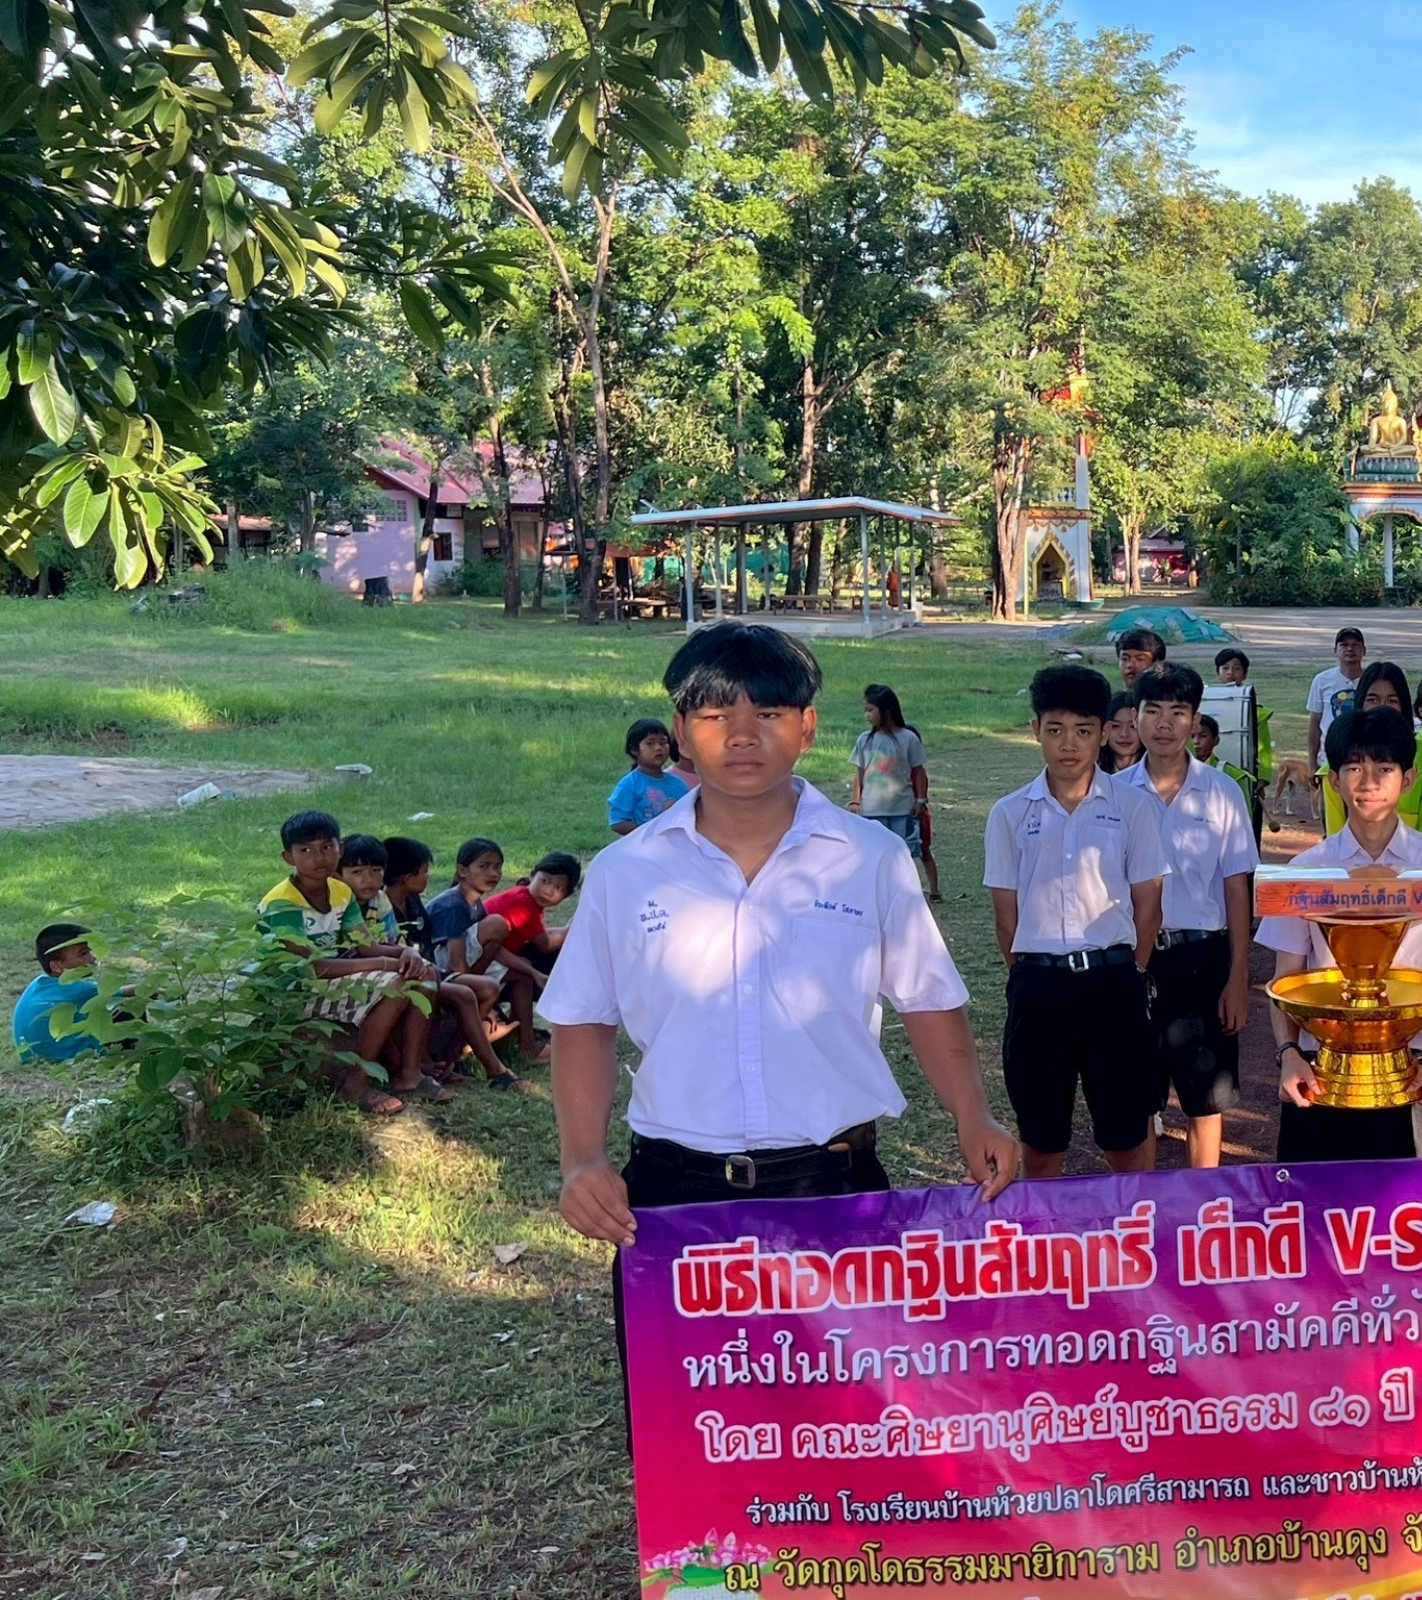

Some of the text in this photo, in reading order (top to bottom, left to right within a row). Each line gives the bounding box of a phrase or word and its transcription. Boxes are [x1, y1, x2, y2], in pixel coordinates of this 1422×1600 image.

[673, 1200, 1157, 1322] พิธีทอดกฐินสัมฤทธิ์
[1177, 1197, 1306, 1286] เด็กดี
[695, 1410, 782, 1462] โดย
[792, 1382, 1298, 1462] คณะศิษยานุศิษย์บูชาธรรม
[1309, 1387, 1370, 1428] ๘๑
[1380, 1366, 1415, 1422] ปี
[746, 1493, 829, 1525] ร่วมกับ
[840, 1473, 1250, 1523] โรงเรียนบ้านห้วยปลาโดศรีสามารถ
[725, 1562, 759, 1592] ณ
[773, 1541, 1159, 1598] วัดกุดโดธรรมมายิการาม
[1175, 1520, 1388, 1572] อำเภอบ้านดุง
